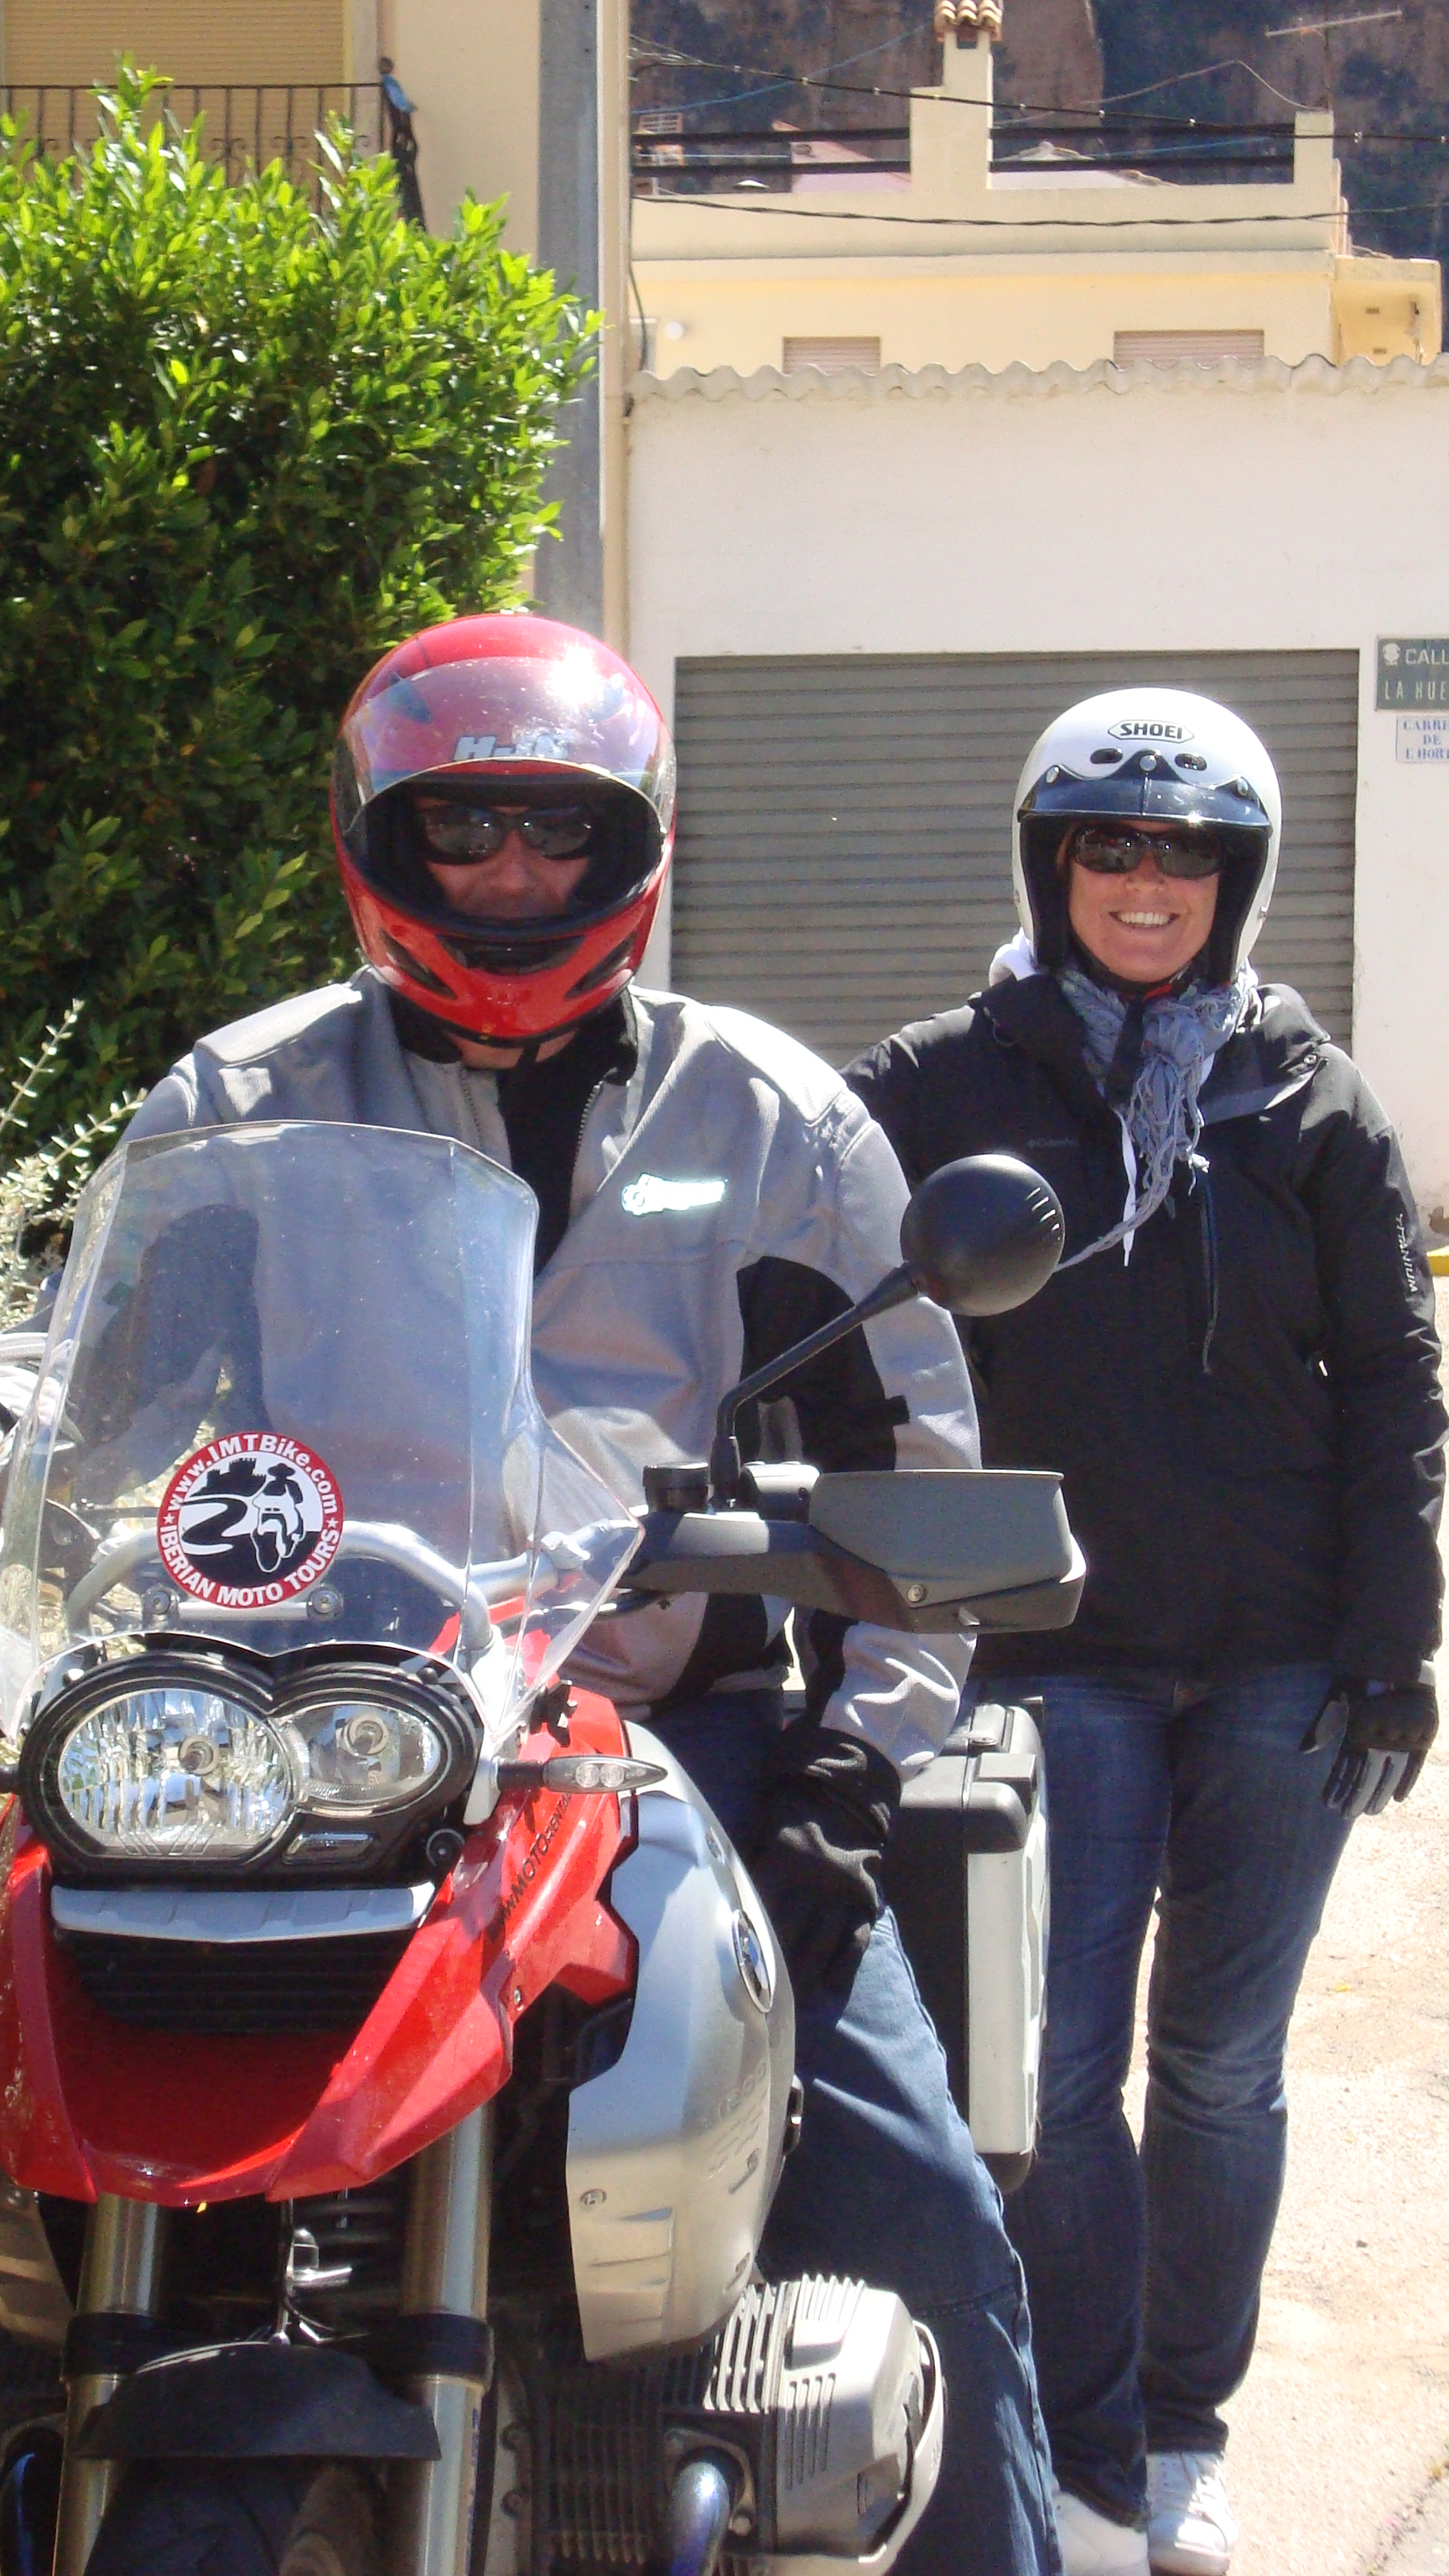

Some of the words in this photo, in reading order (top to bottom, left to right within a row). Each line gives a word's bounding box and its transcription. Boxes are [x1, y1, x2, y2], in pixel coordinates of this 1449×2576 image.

[1405, 648, 1449, 665] CALL
[1384, 680, 1404, 700] LA
[1415, 680, 1446, 701] HUE
[1119, 723, 1183, 740] SHOEI
[1423, 735, 1441, 745] DE
[1395, 1213, 1418, 1293] TITANIUM
[168, 1434, 338, 1514] www.IMTBike.com
[159, 1524, 216, 1599] IBERIAN
[216, 1582, 283, 1607] MOTO
[283, 1528, 340, 1590] TOURS
